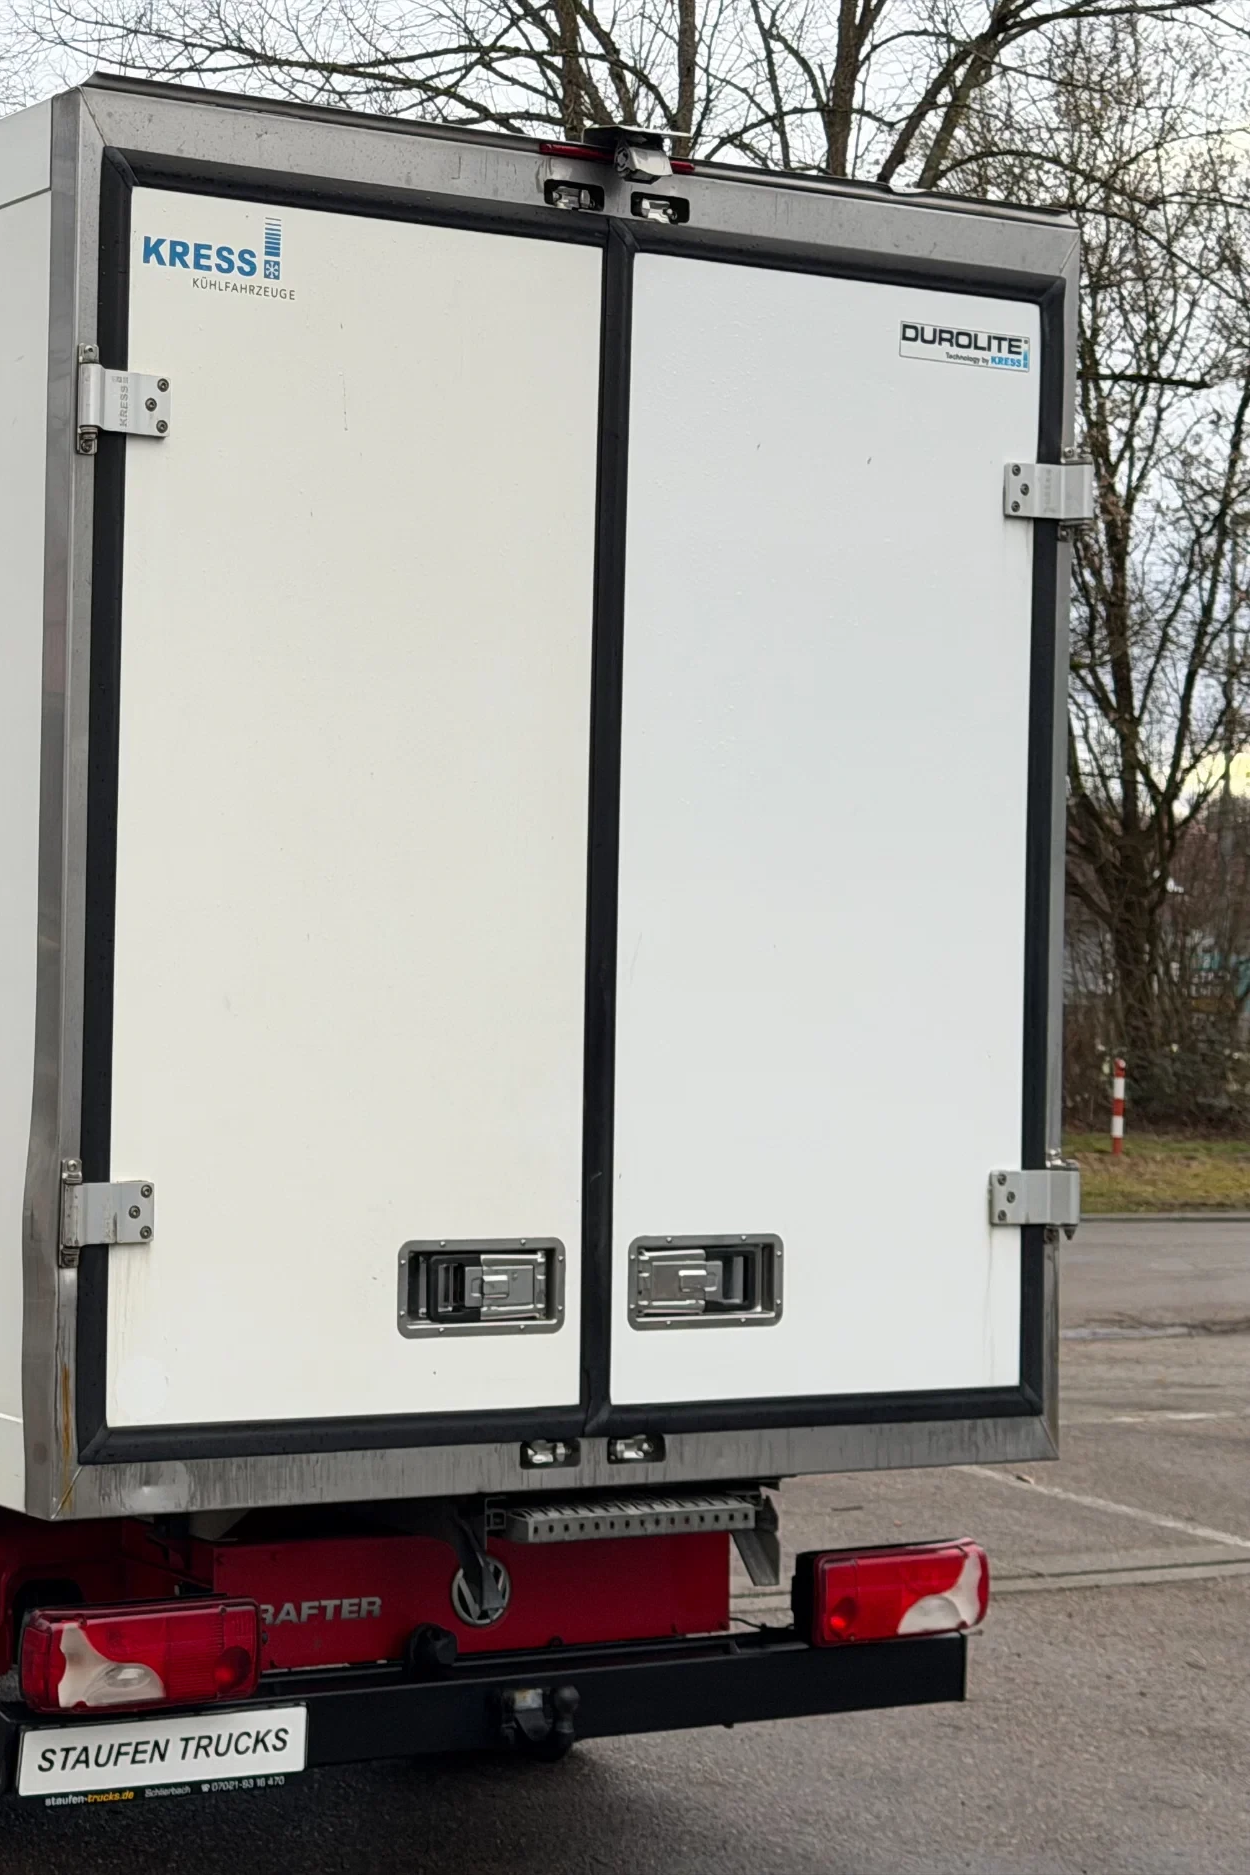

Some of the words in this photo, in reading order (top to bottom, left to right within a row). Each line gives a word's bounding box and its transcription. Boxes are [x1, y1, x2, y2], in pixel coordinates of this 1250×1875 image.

[142, 235, 258, 278] KRESS
[192, 277, 296, 301] KÜHLFAHRZEUGE
[901, 323, 1023, 356] DUROLITE
[945, 351, 981, 365] Technology
[981, 356, 990, 366] by
[990, 355, 1022, 367] KRESS
[119, 385, 129, 427] KRESS
[259, 1596, 383, 1625] RAFTER
[37, 1739, 170, 1772] STAUFEN
[178, 1727, 290, 1761] TRUCKS
[44, 1789, 135, 1807] staufen-trucks.de
